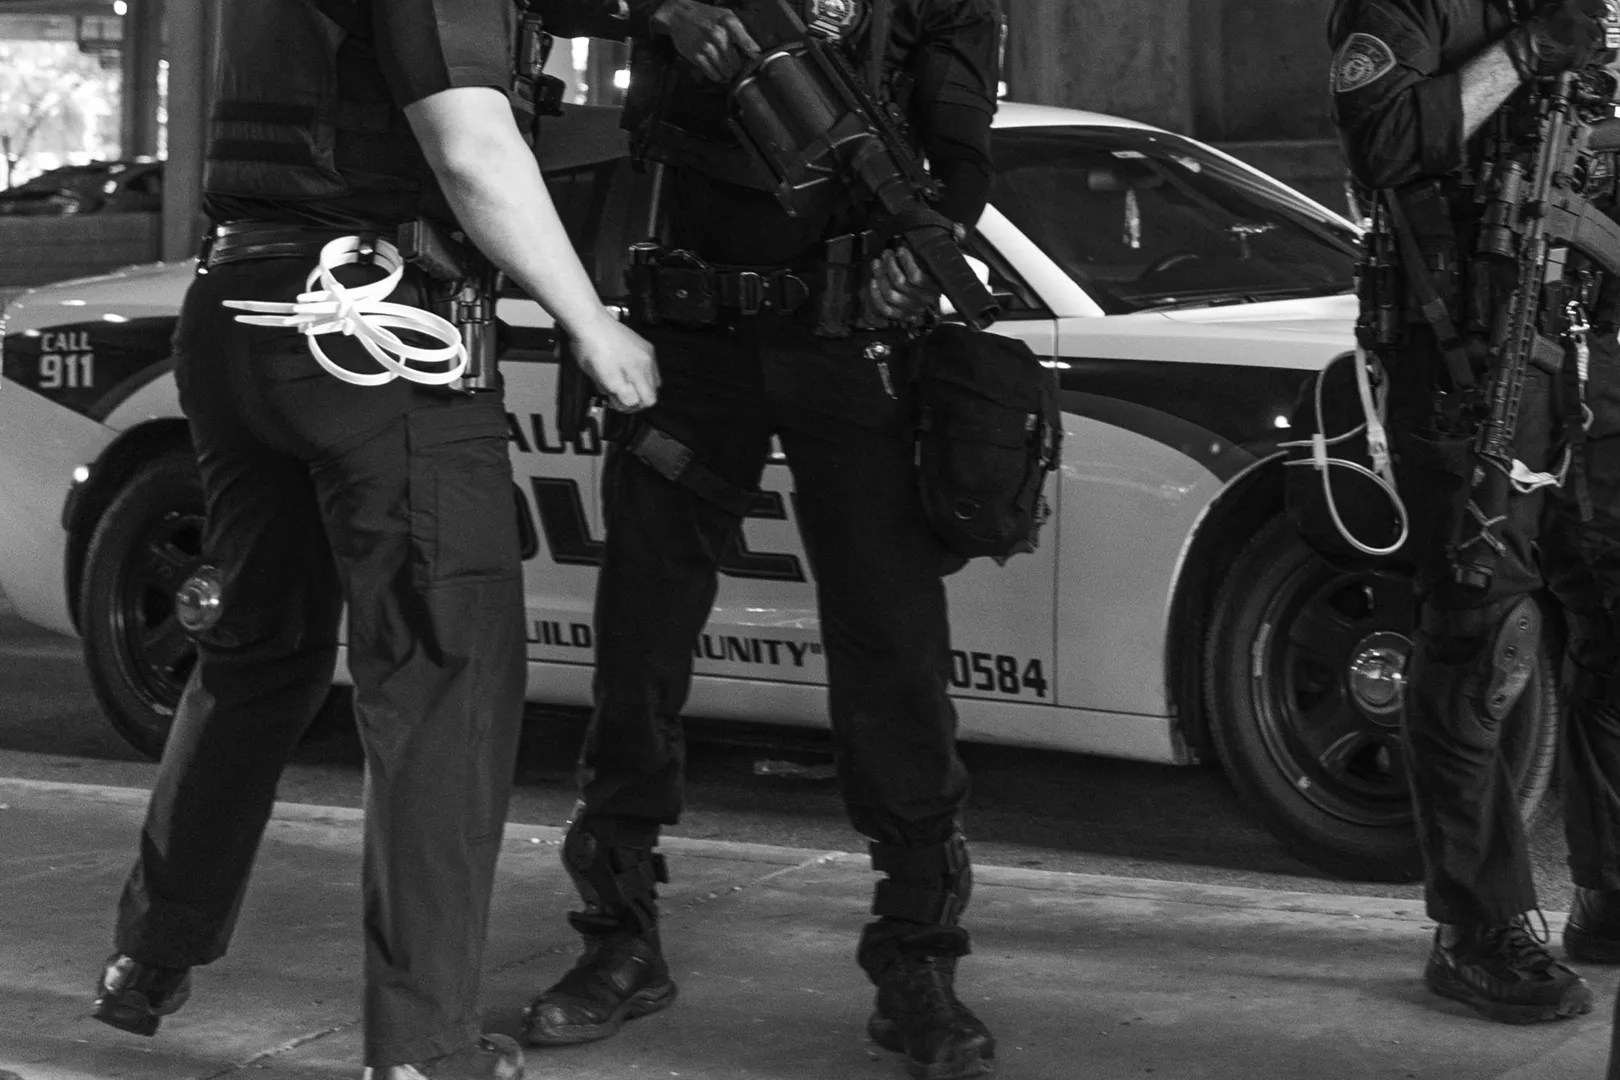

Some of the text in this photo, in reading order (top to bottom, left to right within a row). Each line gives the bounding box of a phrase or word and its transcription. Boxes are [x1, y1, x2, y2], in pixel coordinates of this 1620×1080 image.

[41, 331, 94, 352] CALL
[40, 353, 94, 388] 911
[526, 620, 594, 649] UILD
